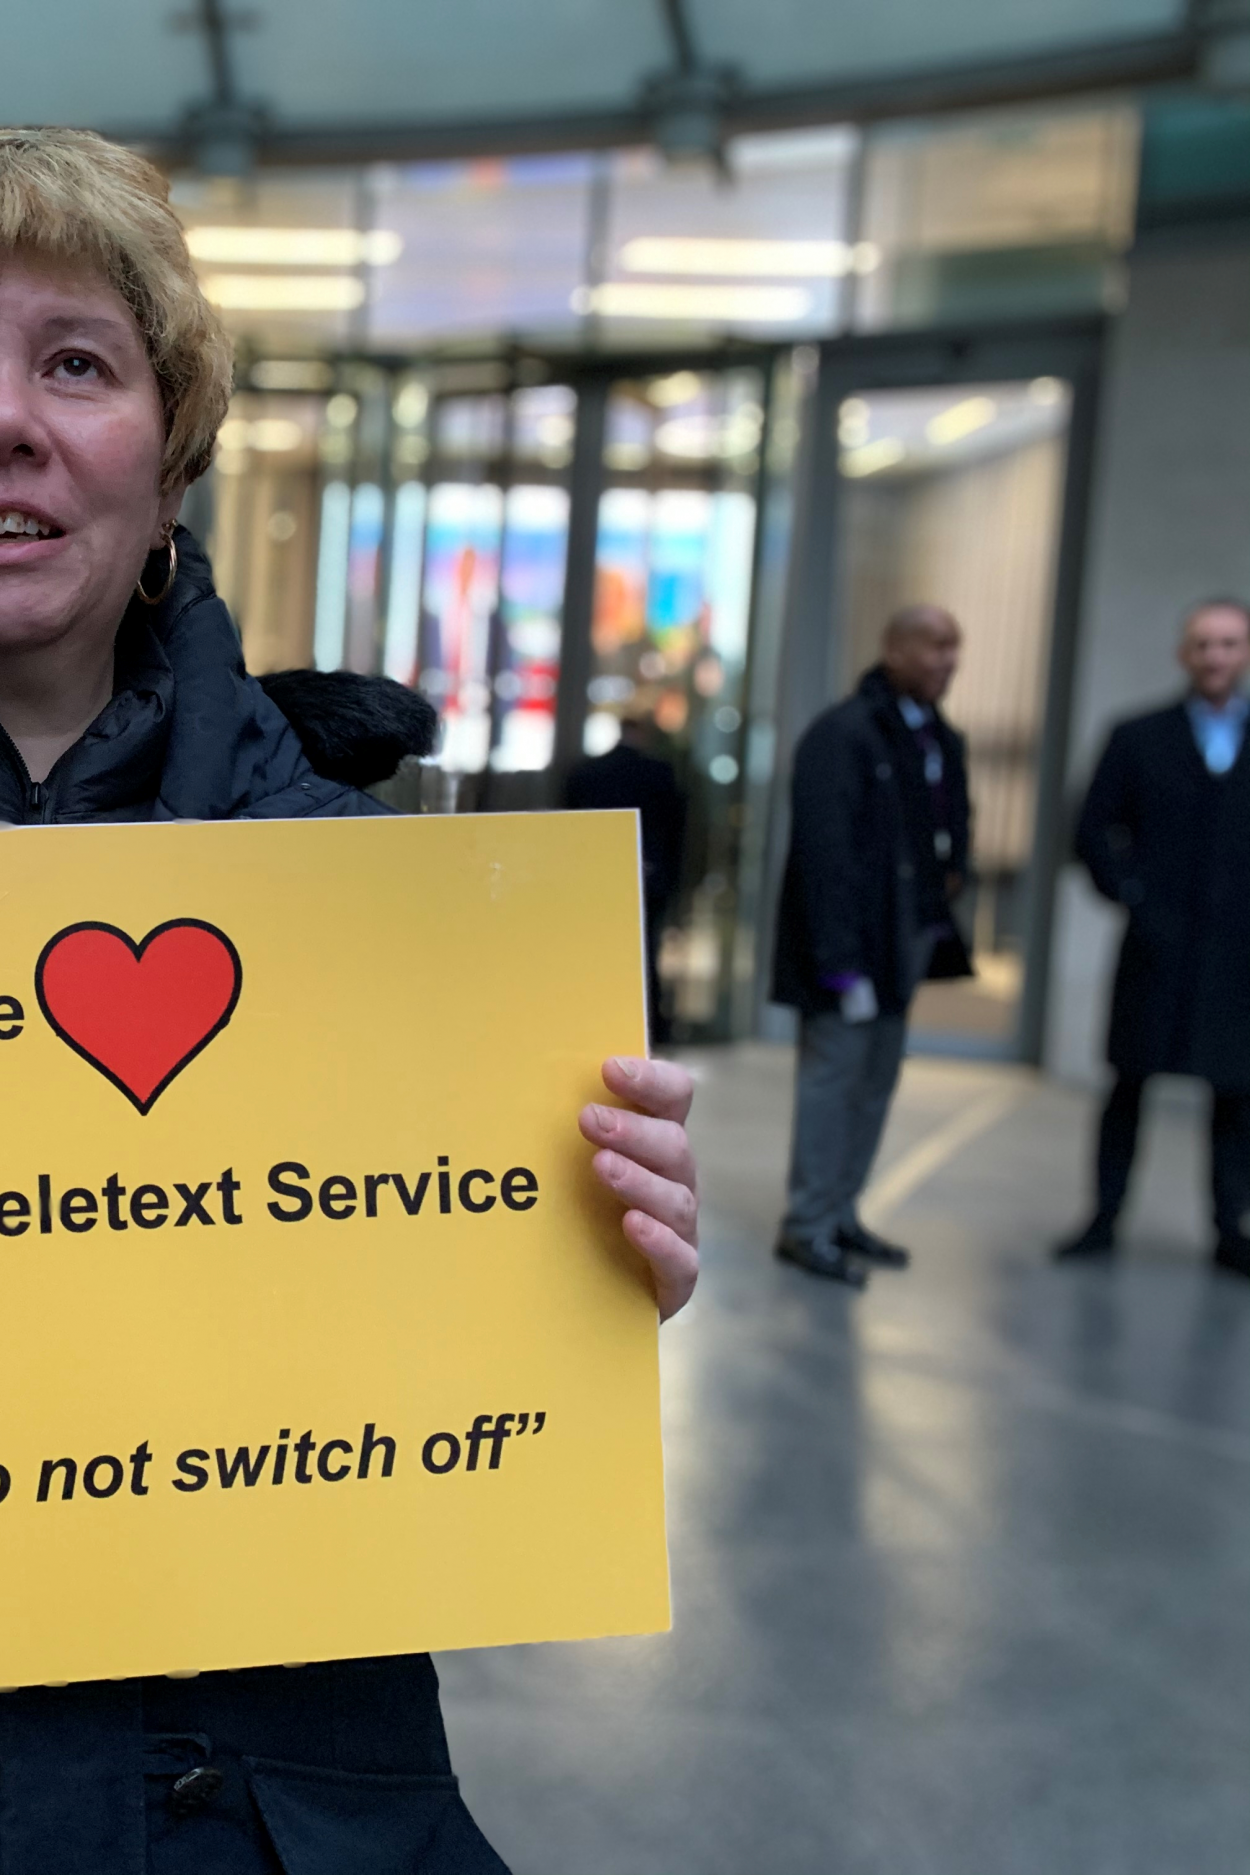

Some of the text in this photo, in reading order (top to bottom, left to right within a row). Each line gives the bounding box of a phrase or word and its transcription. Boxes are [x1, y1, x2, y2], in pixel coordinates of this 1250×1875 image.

[267, 1155, 539, 1224] Service
[37, 1440, 153, 1502] not
[172, 1424, 396, 1493] switch
[421, 1411, 546, 1475] off”
